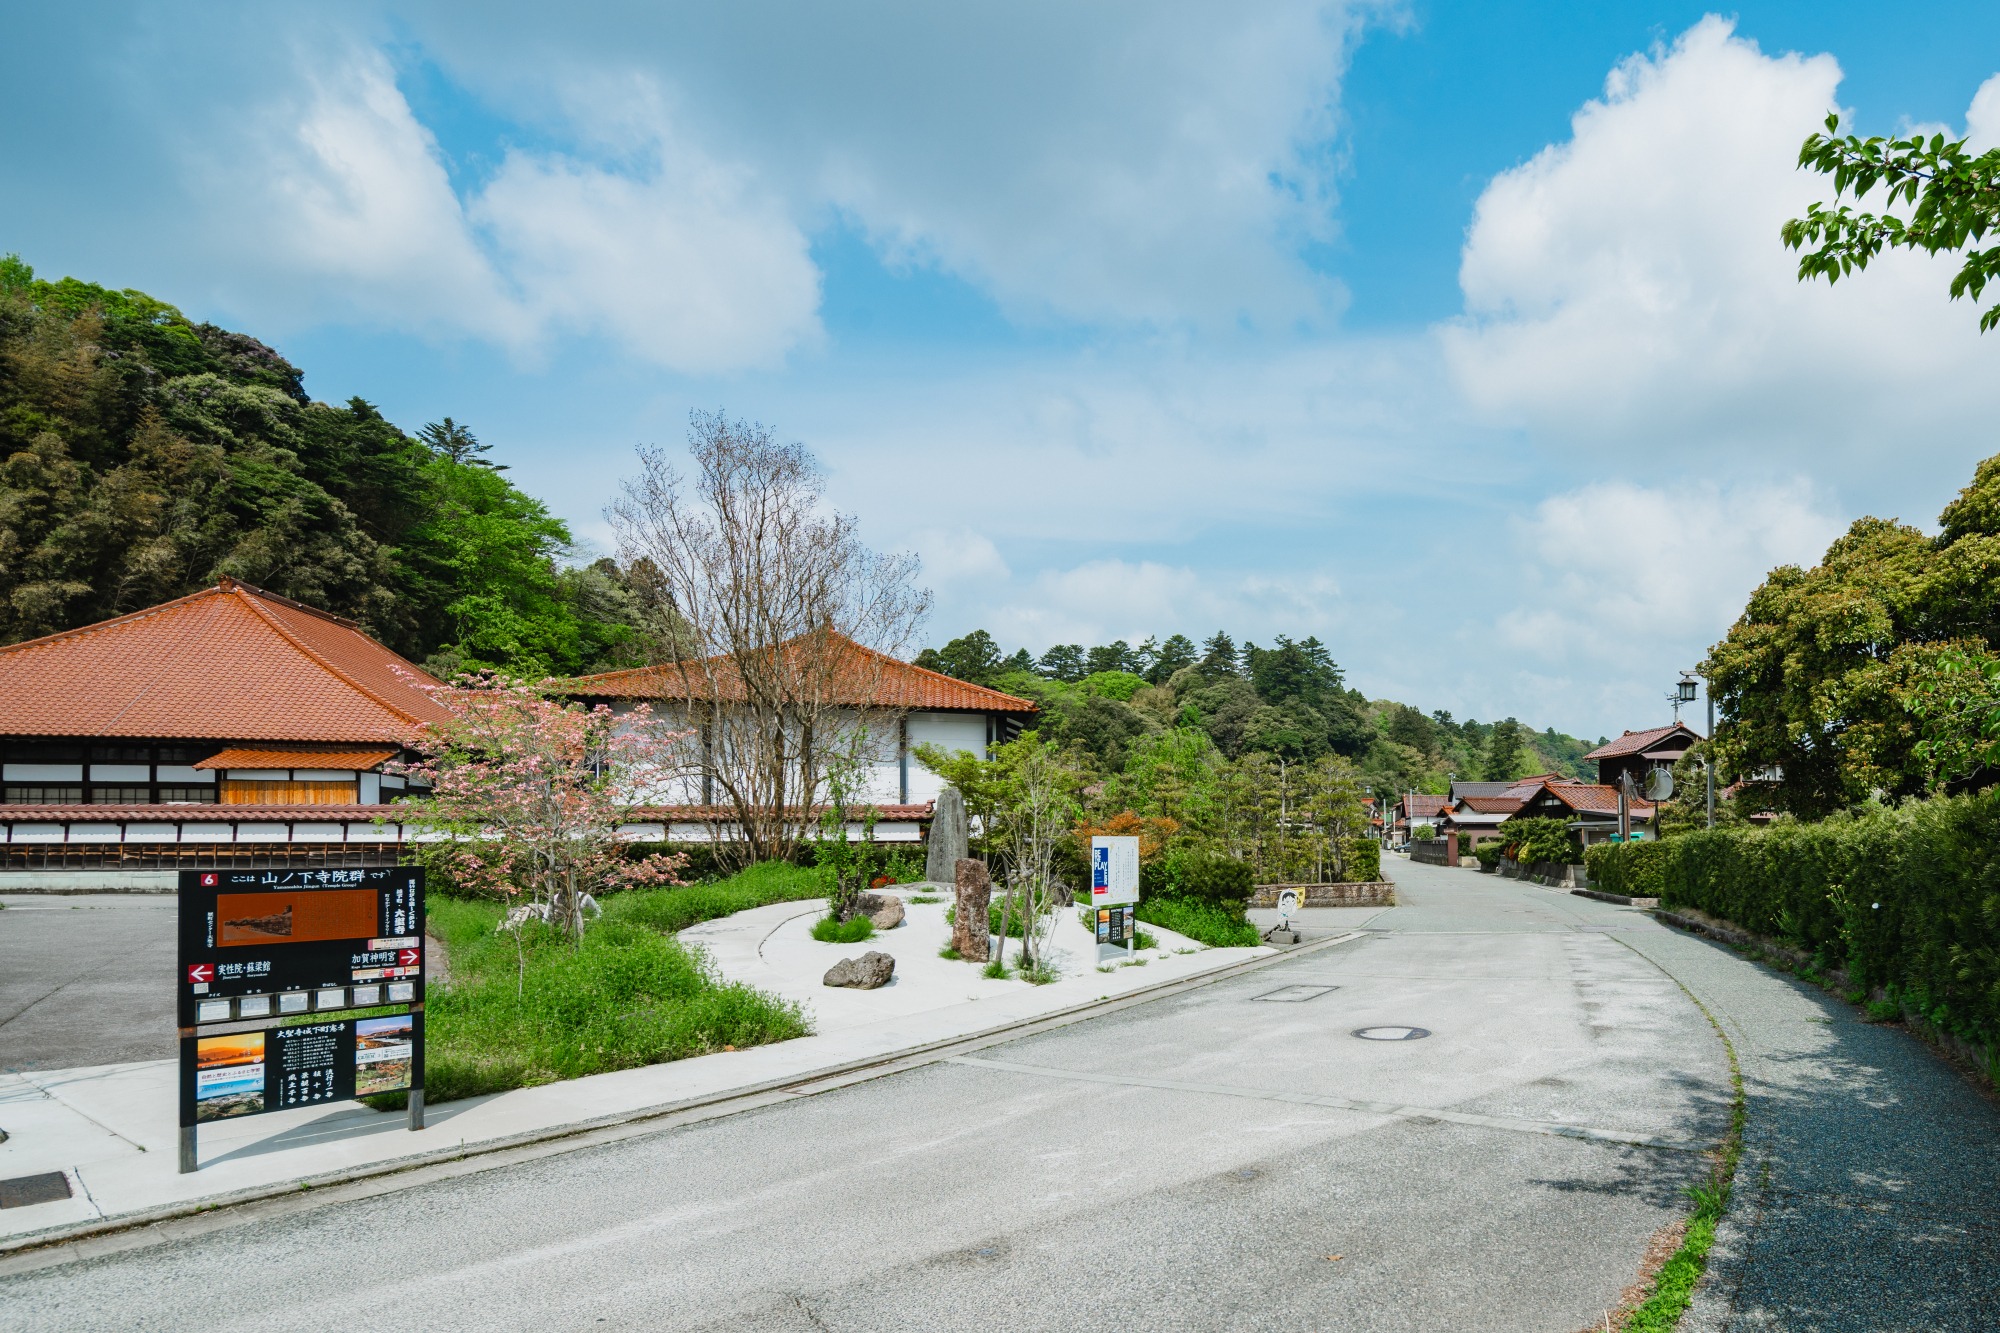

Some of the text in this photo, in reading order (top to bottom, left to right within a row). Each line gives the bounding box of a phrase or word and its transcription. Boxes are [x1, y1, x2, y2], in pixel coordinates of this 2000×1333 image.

[204, 874, 214, 885] 6
[231, 869, 386, 885] ここは 山ノ下寺院群 です
[351, 951, 396, 964] 加賀神明宮
